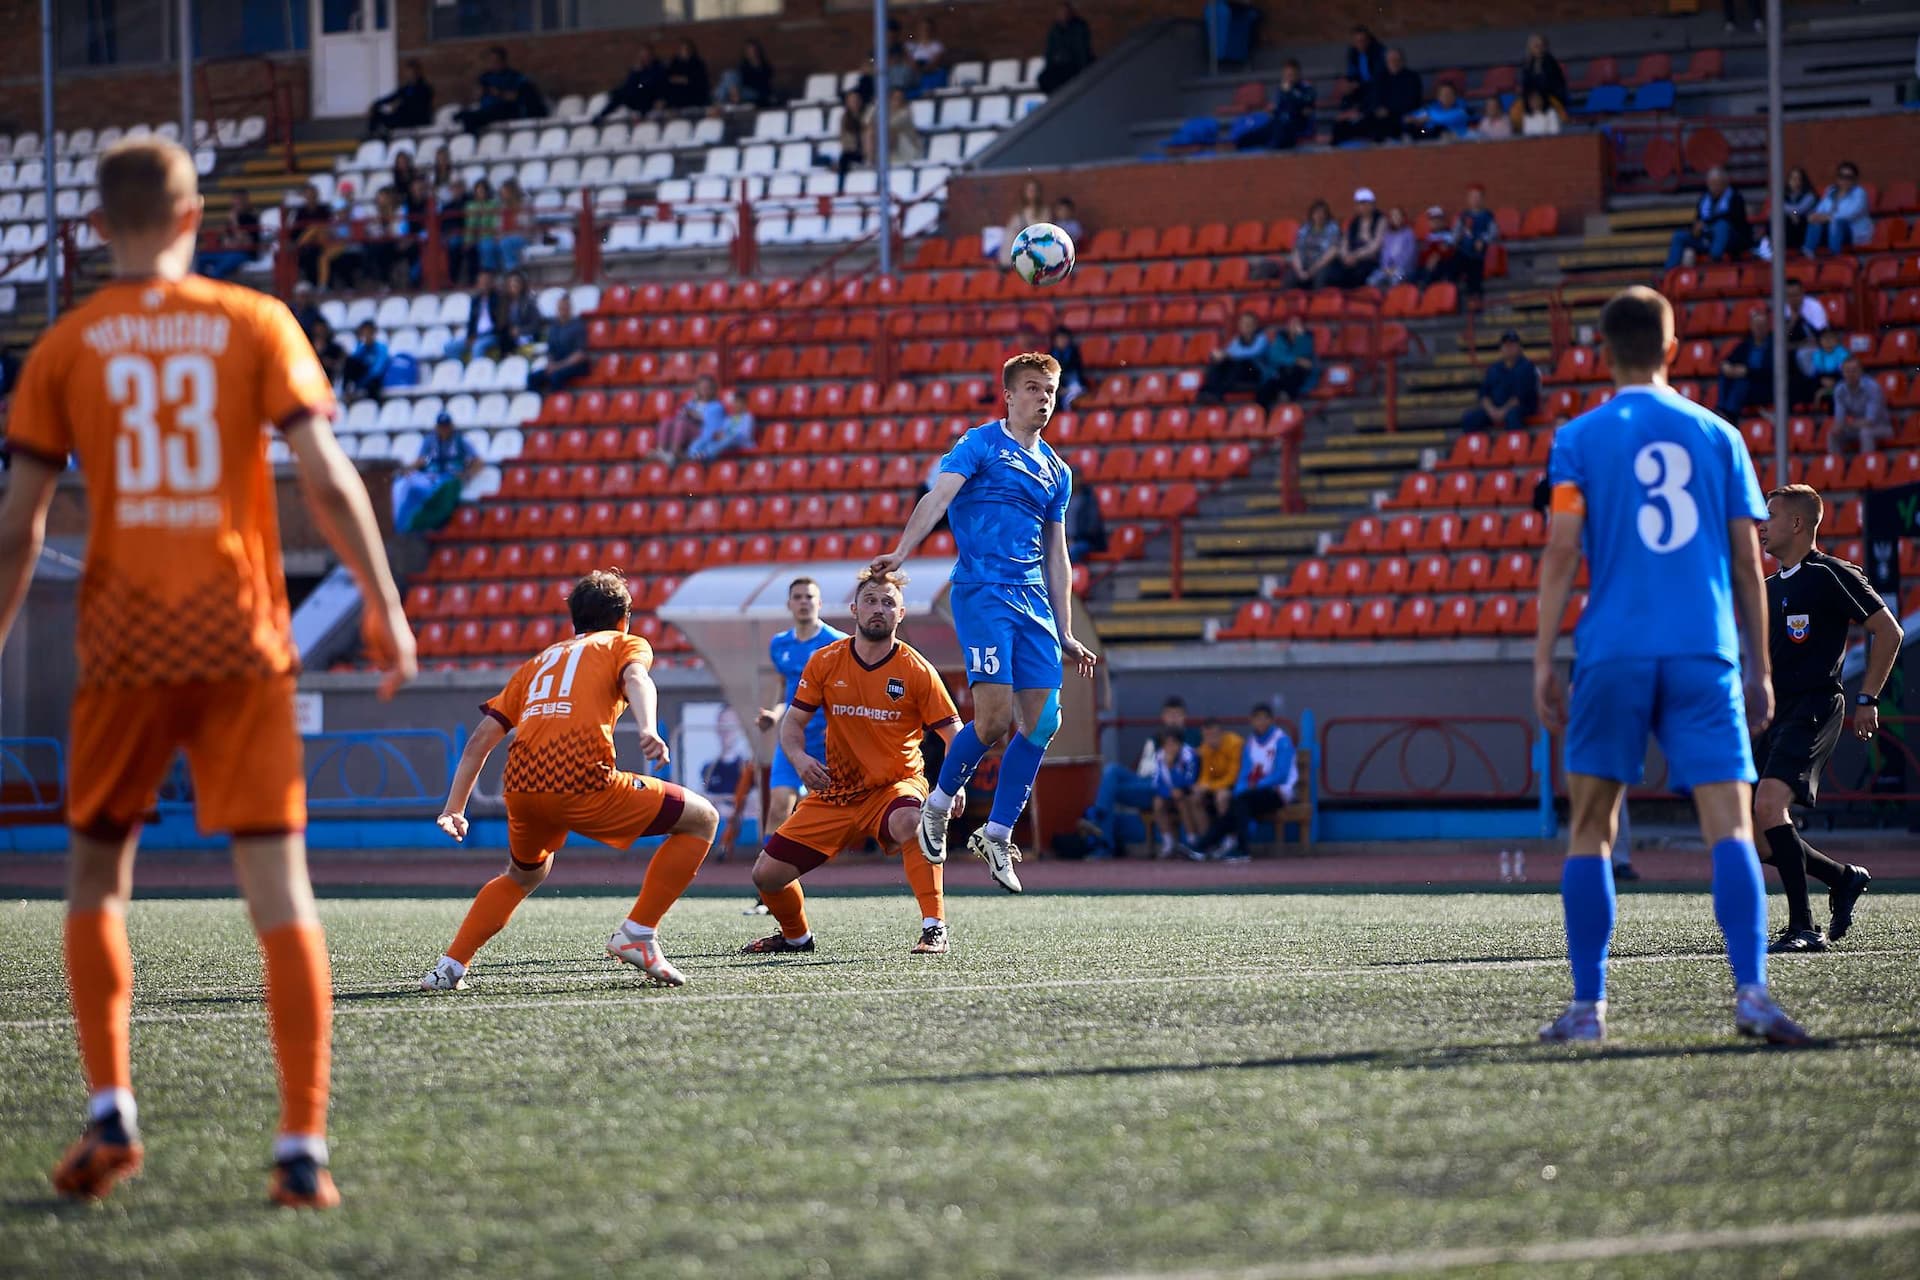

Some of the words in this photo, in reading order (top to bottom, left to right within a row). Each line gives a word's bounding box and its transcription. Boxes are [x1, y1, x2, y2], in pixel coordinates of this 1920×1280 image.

[106, 354, 222, 492] 33
[1633, 441, 1699, 553] 3
[526, 643, 587, 705] 21
[968, 646, 1000, 675] 15
